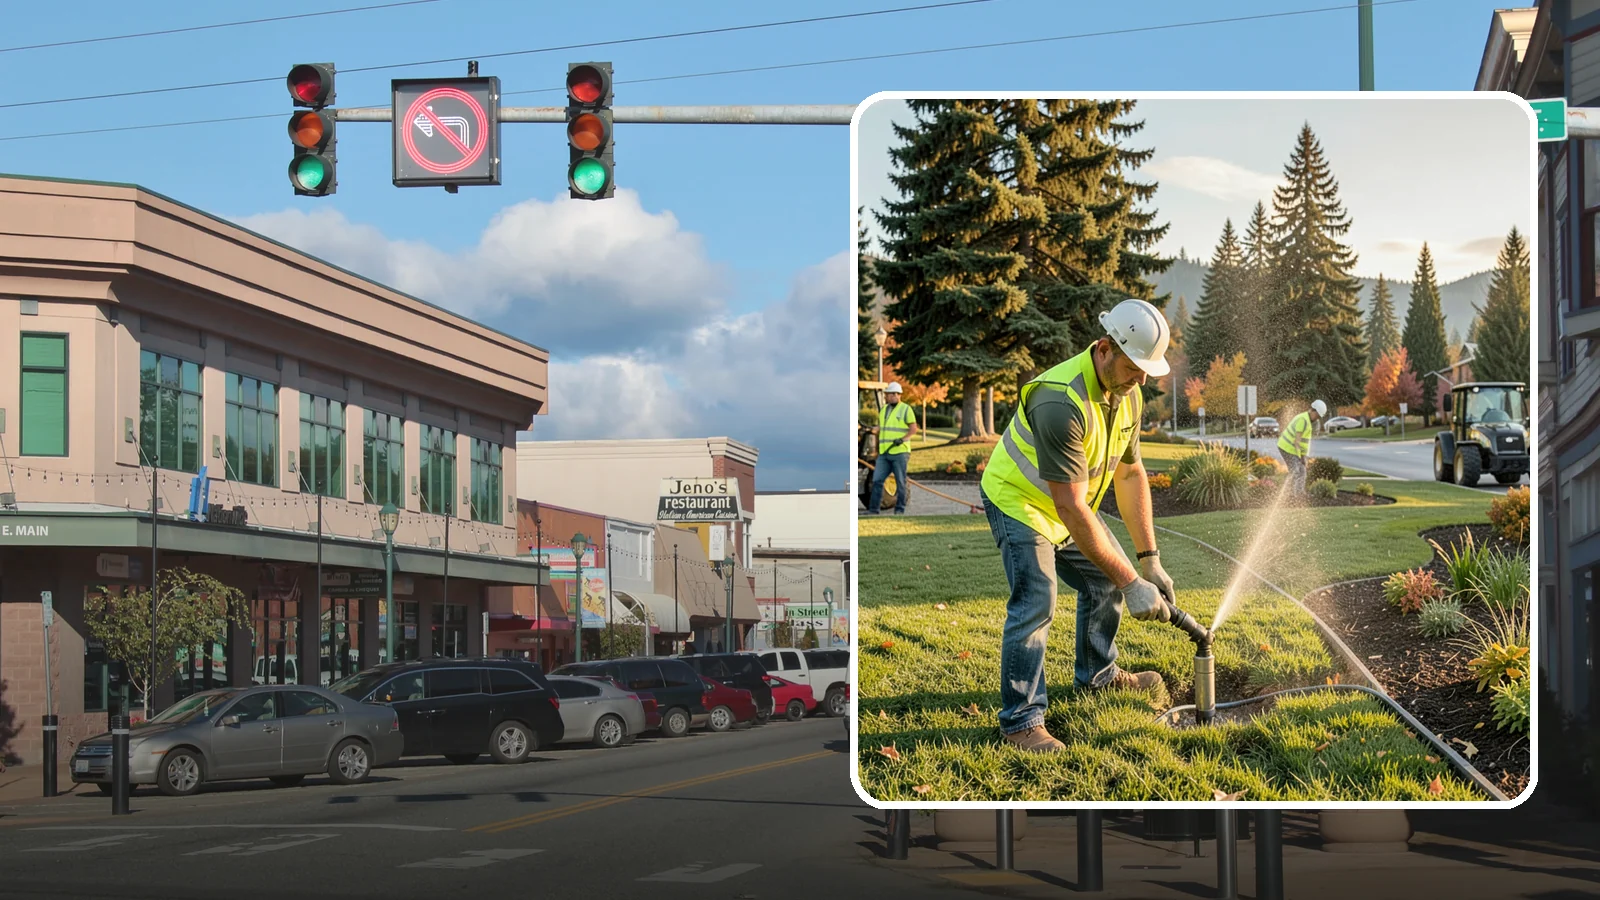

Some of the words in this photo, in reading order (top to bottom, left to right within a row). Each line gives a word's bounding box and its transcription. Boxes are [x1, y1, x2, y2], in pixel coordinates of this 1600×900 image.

[669, 480, 727, 495] Jeno's
[665, 496, 731, 509] restaurant
[686, 509, 715, 519] American
[715, 509, 738, 519] Cuisine
[2, 525, 13, 536] E.
[15, 525, 49, 536] MAIN
[797, 607, 828, 616] Street
